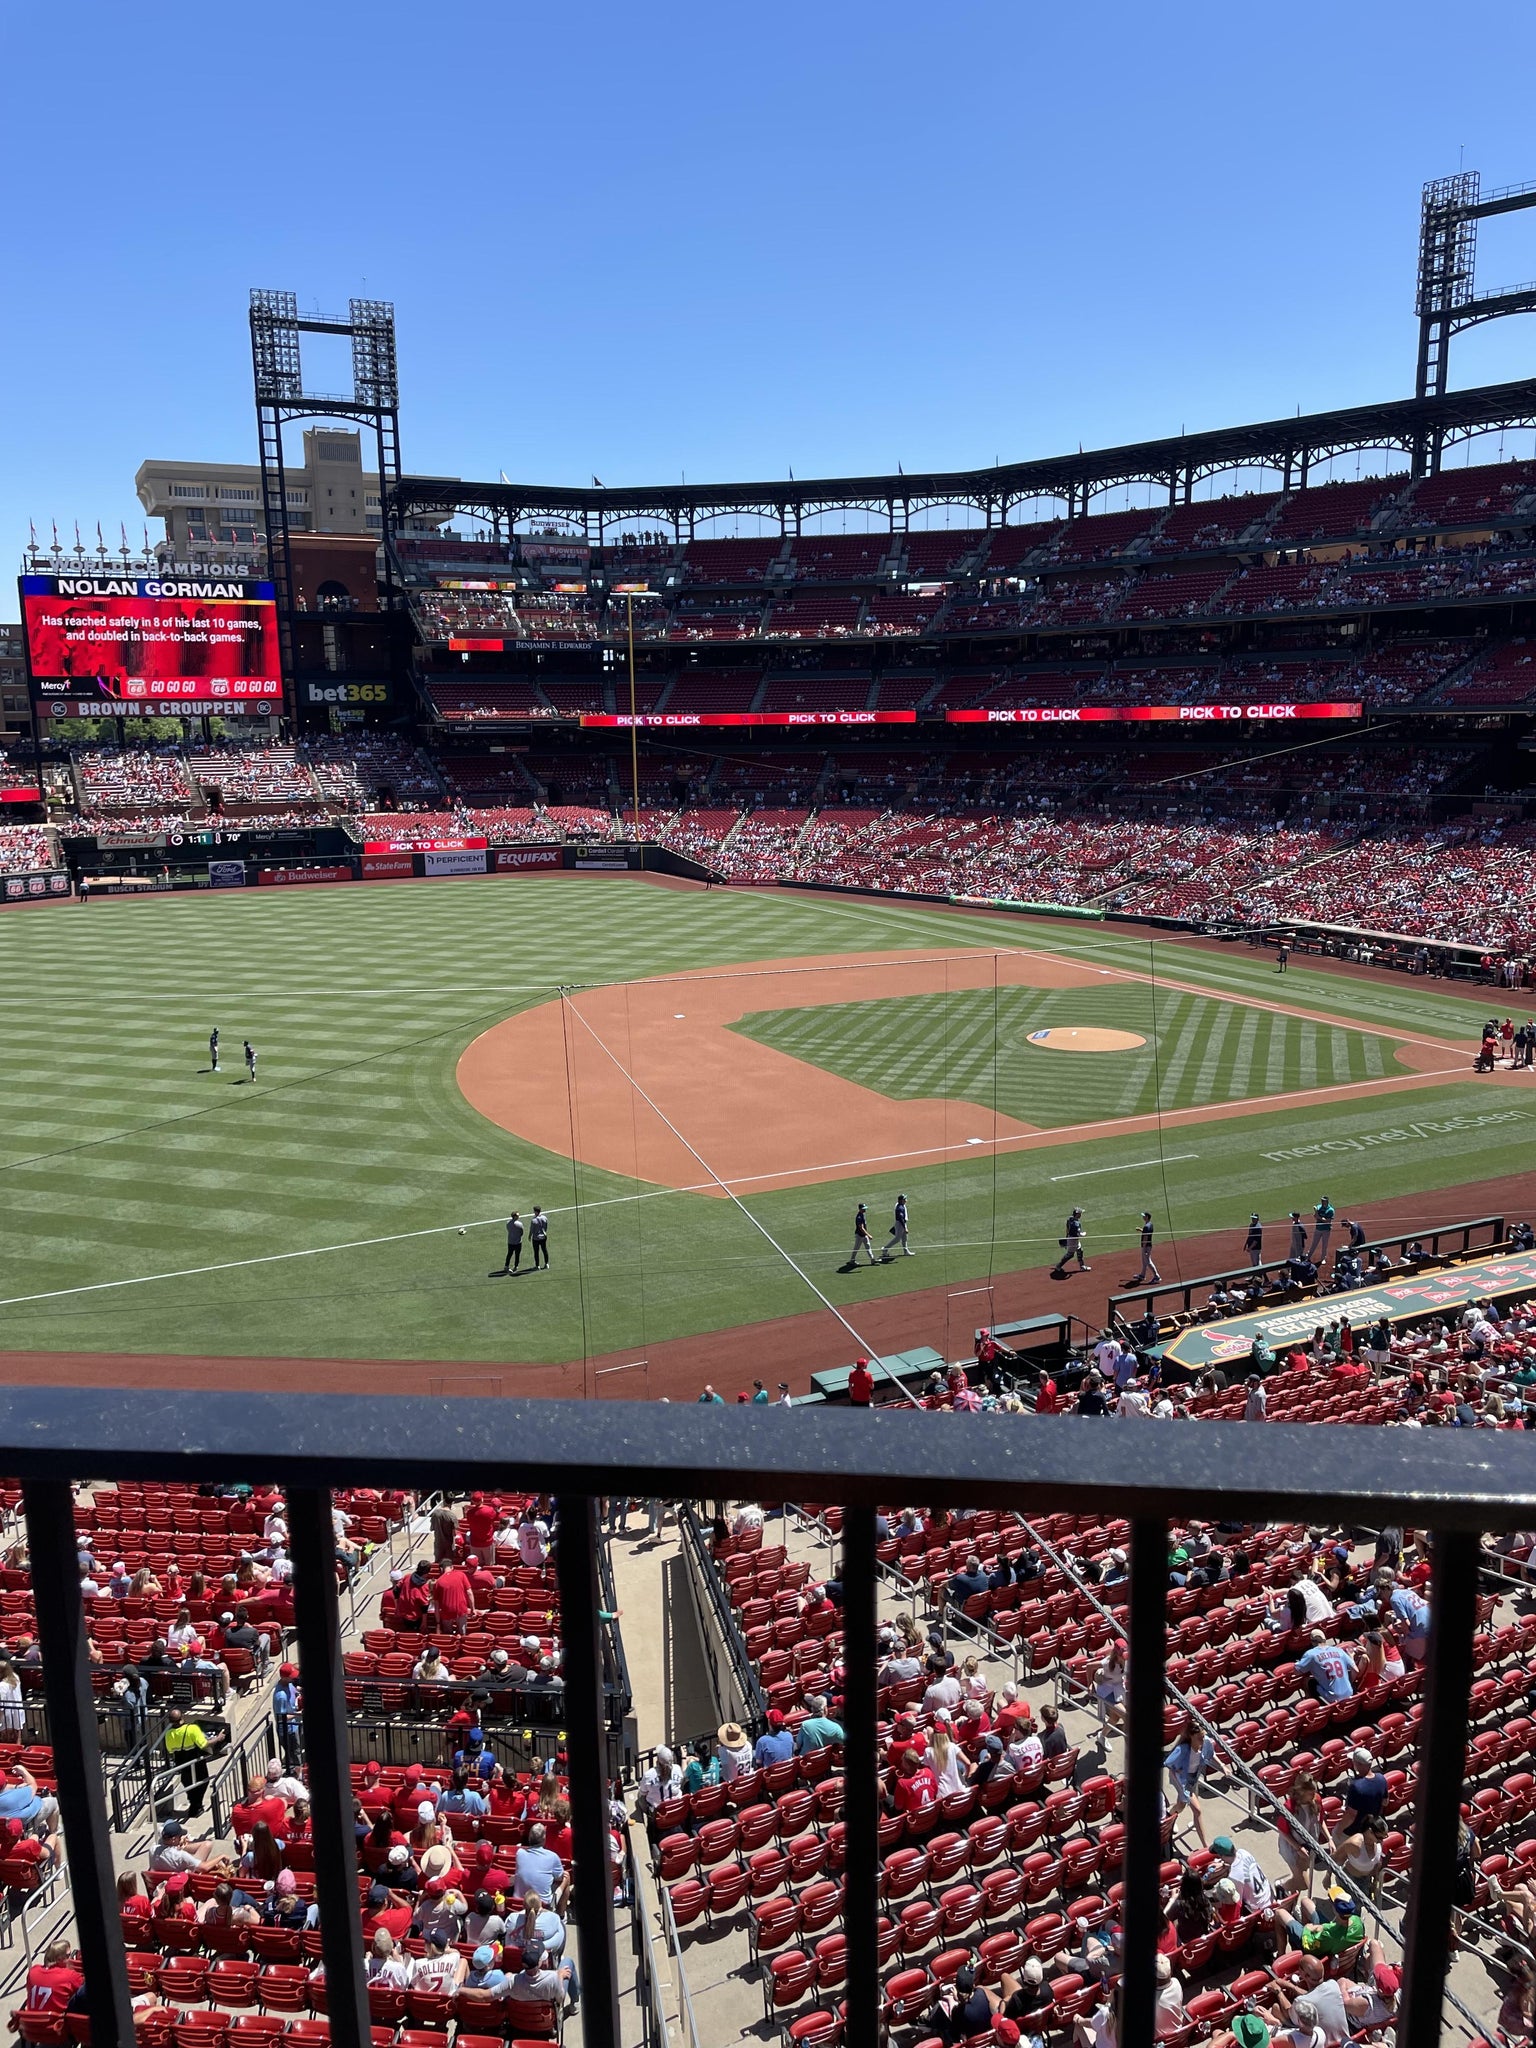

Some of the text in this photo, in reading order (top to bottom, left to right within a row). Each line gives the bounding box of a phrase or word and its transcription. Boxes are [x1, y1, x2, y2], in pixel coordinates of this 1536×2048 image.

[129, 560, 249, 576] CHAMPIONS
[58, 579, 244, 598] NOLAN GORMAN
[42, 615, 262, 631] Has reached safely in 8 of his last 10 games,
[66, 630, 245, 645] and doubled in back-to-back games.
[516, 641, 549, 649] BENJAMIN
[559, 641, 592, 649] EDWARDS
[41, 682, 66, 692] Mercy
[130, 680, 196, 693] 66 GO GO GO
[214, 681, 277, 693] 66 GO GO GO
[309, 684, 387, 702] bet365
[78, 701, 245, 716] BROWN & CROUPPEN
[1180, 706, 1296, 719] PICK TO CLICK
[617, 716, 700, 725] PICK TO CLICK
[789, 713, 876, 723] PICK TO CLICK
[988, 710, 1081, 721] PICK TO CLICK
[102, 835, 158, 845] Schnucks
[188, 835, 207, 844] 1:11
[390, 842, 414, 851] PICK
[434, 840, 464, 849] CLICK
[437, 855, 484, 864] PERFICIENT
[498, 852, 557, 866] EQUIFAX
[217, 863, 236, 873] Ford
[288, 871, 338, 881] Budweiser
[108, 881, 173, 893] BUSCH STADIUM
[1259, 1109, 1535, 1162] mercy.net/BeSeen
[1254, 1297, 1379, 1329] NATIONAL LEAGUE
[1268, 1302, 1394, 1337] CHAMPIONS
[1107, 1350, 1114, 1360] 4
[1323, 1660, 1344, 1681] 28
[921, 1789, 931, 1805] 4
[418, 1962, 454, 1977] HOLLIDAY
[429, 1976, 443, 1992] 7
[30, 1984, 53, 2010] 17
